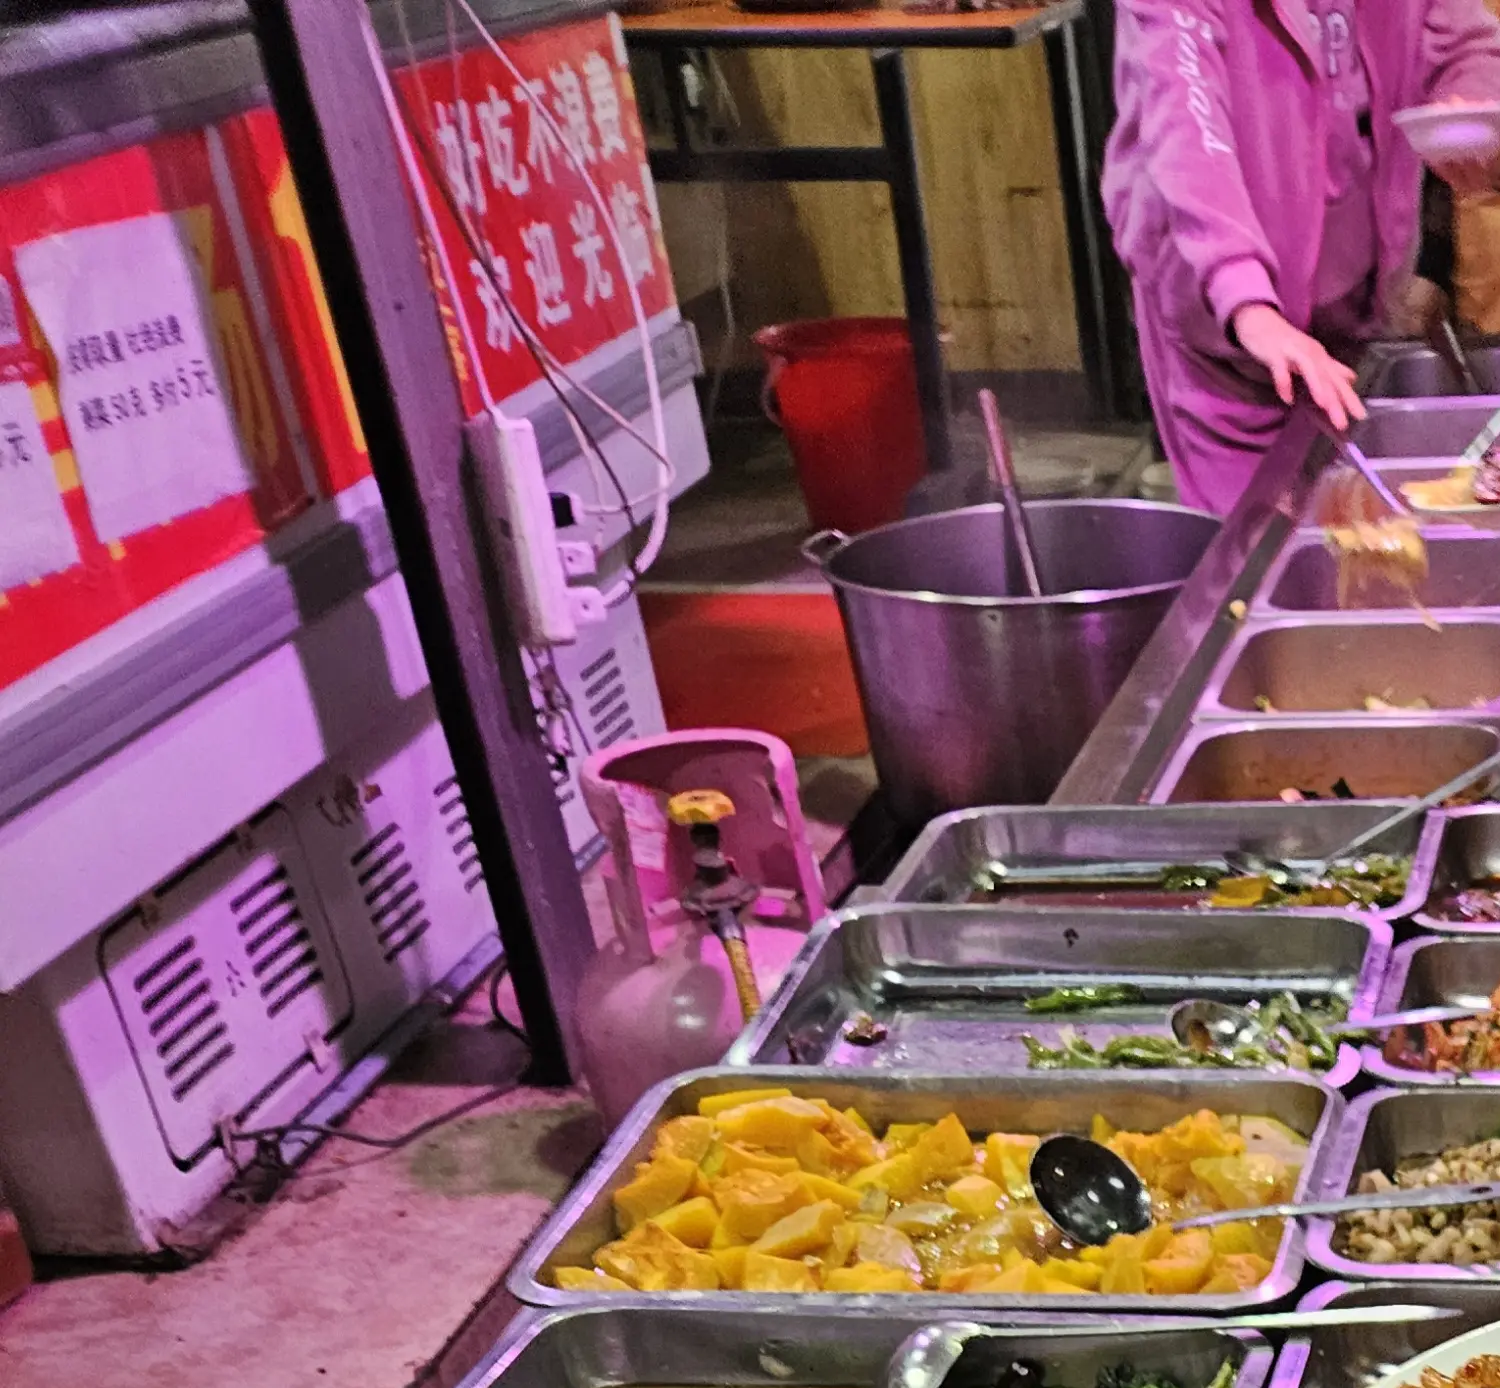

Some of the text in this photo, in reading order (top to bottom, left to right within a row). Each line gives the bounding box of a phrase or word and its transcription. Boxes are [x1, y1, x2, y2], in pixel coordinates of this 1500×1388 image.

[435, 50, 628, 216] 好吃不浪费
[467, 180, 655, 353] 欢迎光临
